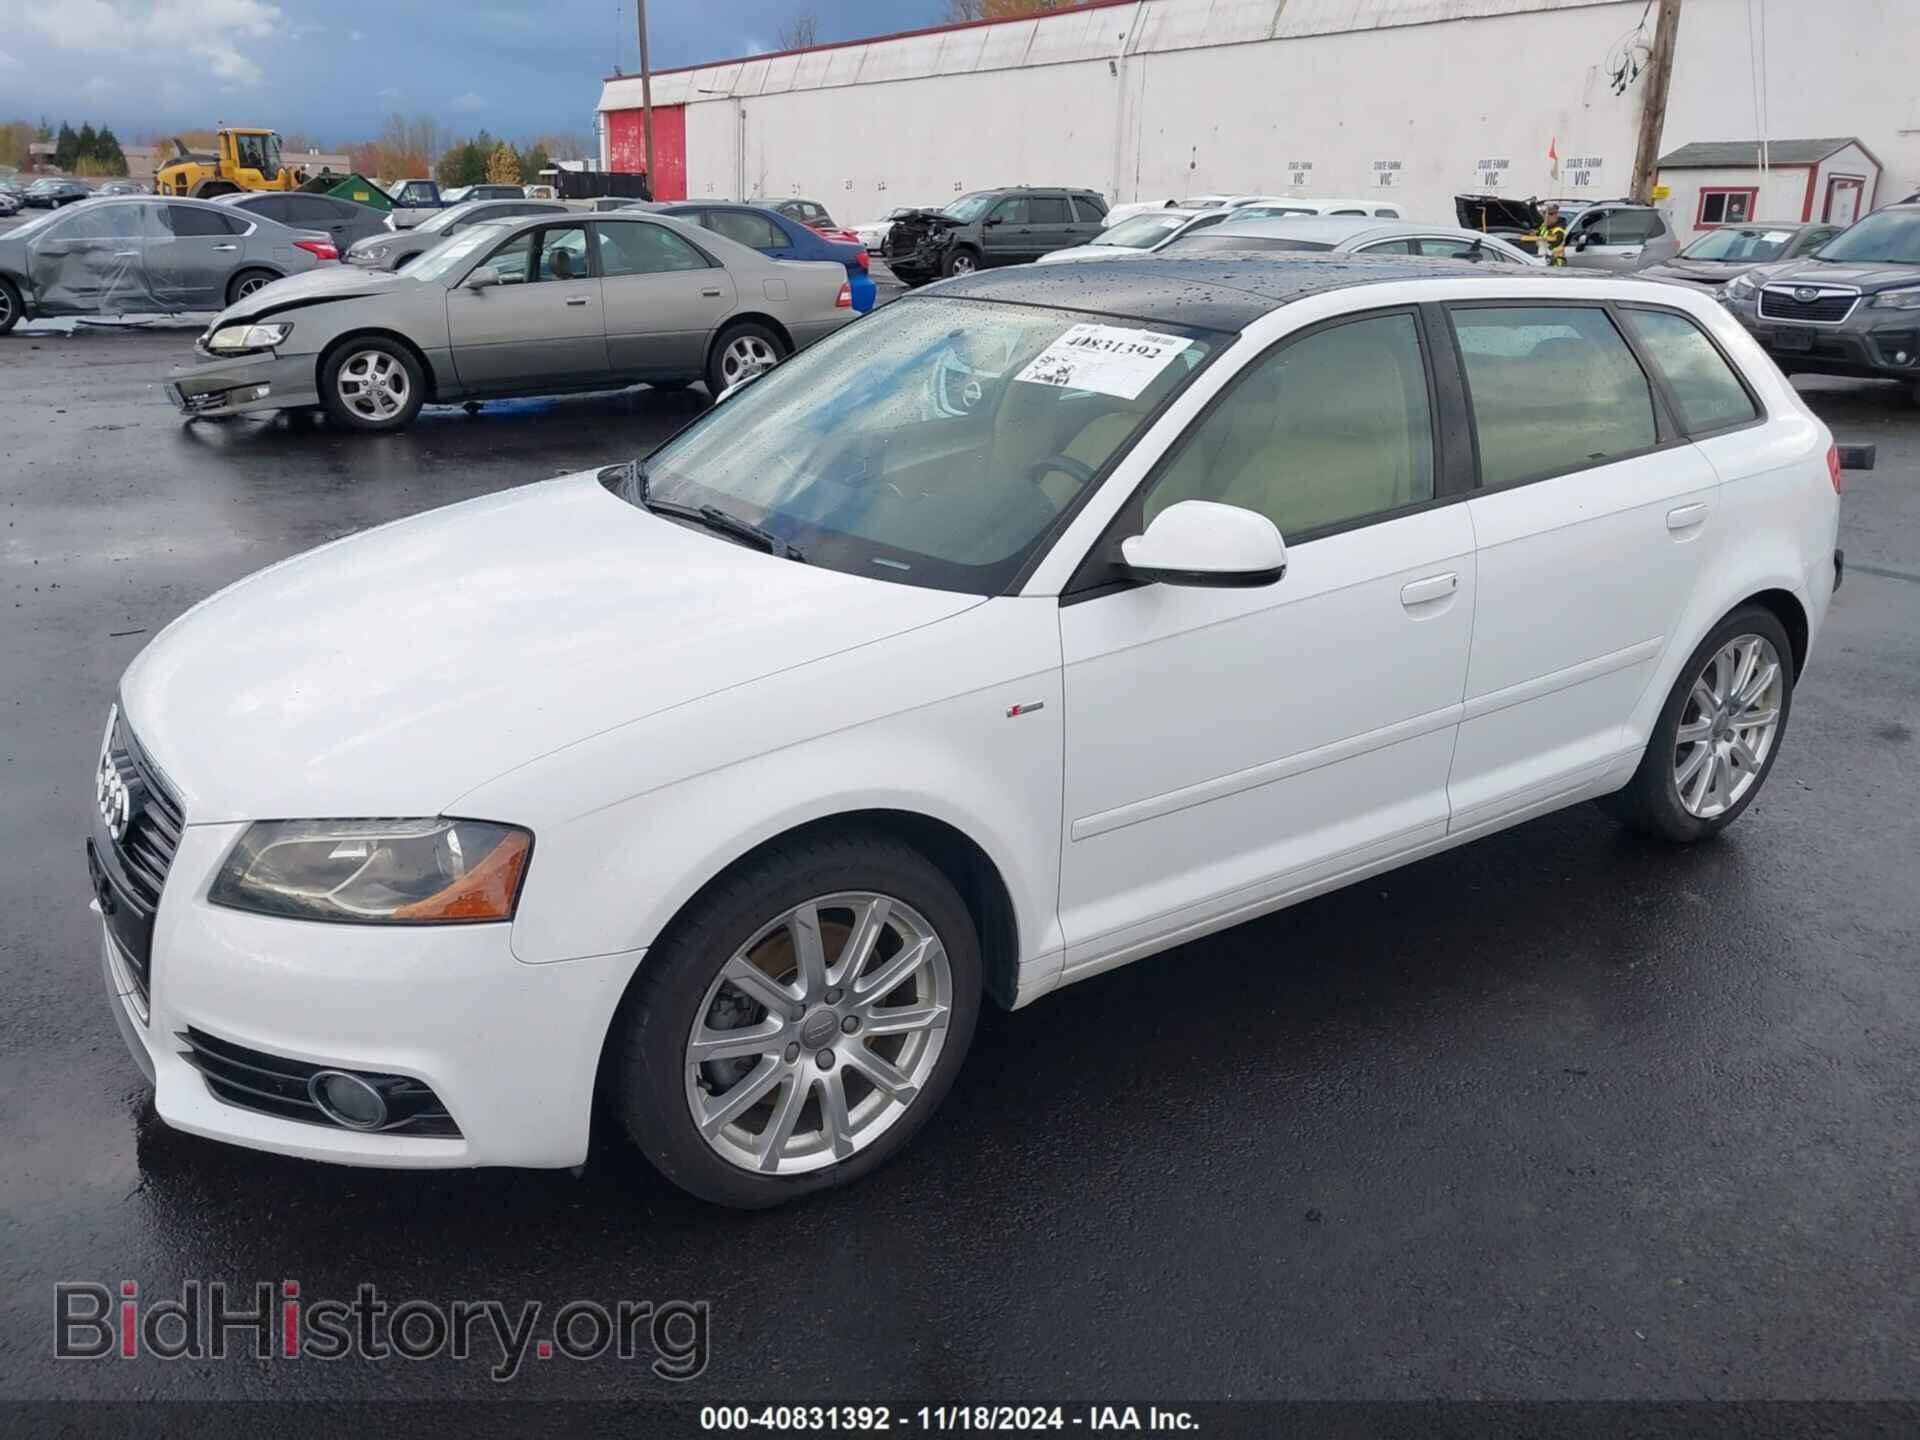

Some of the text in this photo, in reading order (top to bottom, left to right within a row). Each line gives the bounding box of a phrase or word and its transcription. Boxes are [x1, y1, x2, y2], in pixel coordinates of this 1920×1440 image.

[1478, 159, 1509, 170] STATE FARM
[1566, 157, 1602, 169] STATE FARM
[1380, 172, 1392, 186] VIC
[1485, 171, 1499, 186] VIC
[1574, 170, 1590, 186] VIC
